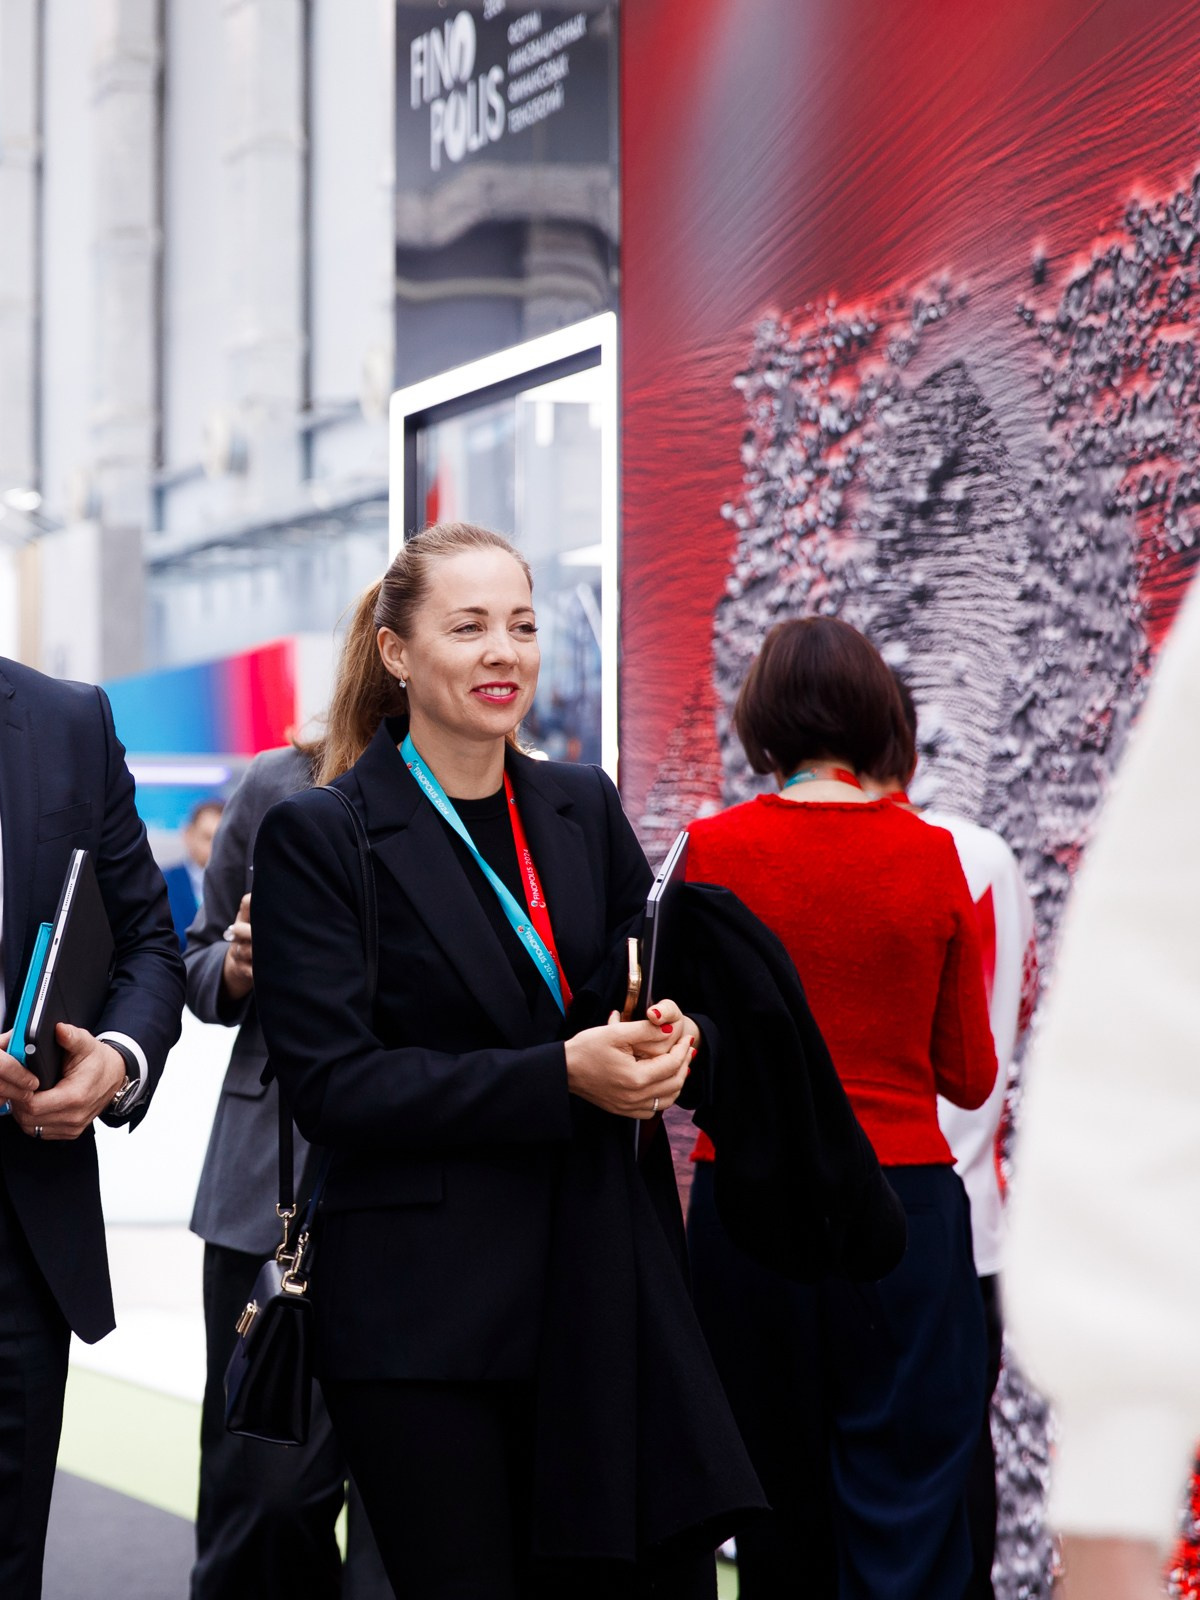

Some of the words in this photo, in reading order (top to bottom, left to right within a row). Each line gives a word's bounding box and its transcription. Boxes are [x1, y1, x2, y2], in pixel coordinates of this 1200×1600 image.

[410, 10, 477, 110] FINO
[429, 65, 505, 172] POLIS
[413, 766, 439, 798] FINOPOLIS
[434, 799, 450, 815] 2024
[523, 848, 533, 865] 2024
[526, 866, 540, 900] FINOPOLIS
[524, 931, 547, 963] FINOPOLIS
[543, 962, 556, 980] 2024
